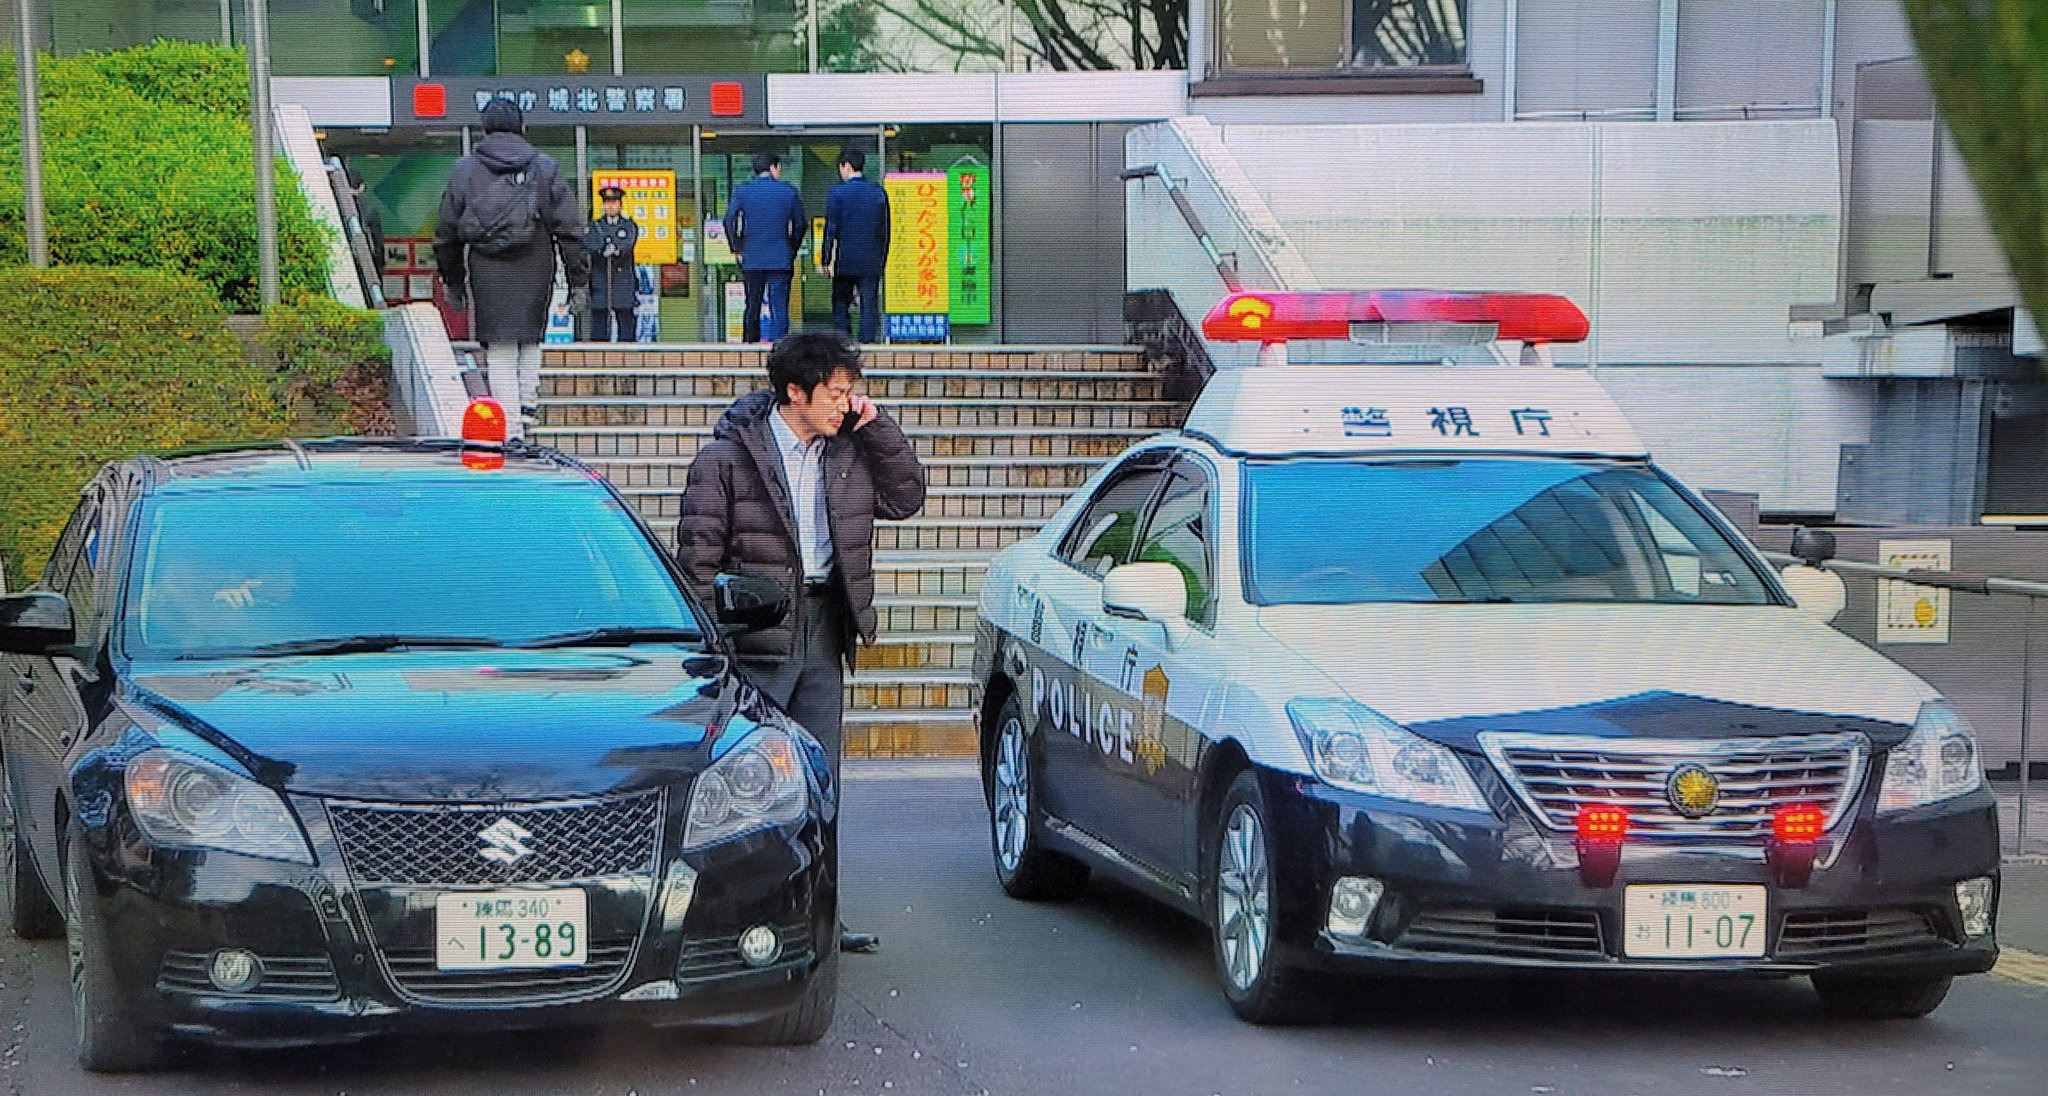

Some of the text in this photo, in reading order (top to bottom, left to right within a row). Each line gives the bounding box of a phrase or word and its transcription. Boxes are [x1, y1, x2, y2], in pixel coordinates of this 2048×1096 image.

[547, 86, 685, 113] 城北警察署
[1341, 406, 1553, 437] 警視庁
[1032, 667, 1135, 765] POLICE
[475, 898, 549, 918] 練馬 340
[480, 921, 576, 961] 13-89
[1665, 913, 1755, 949] 11-07
